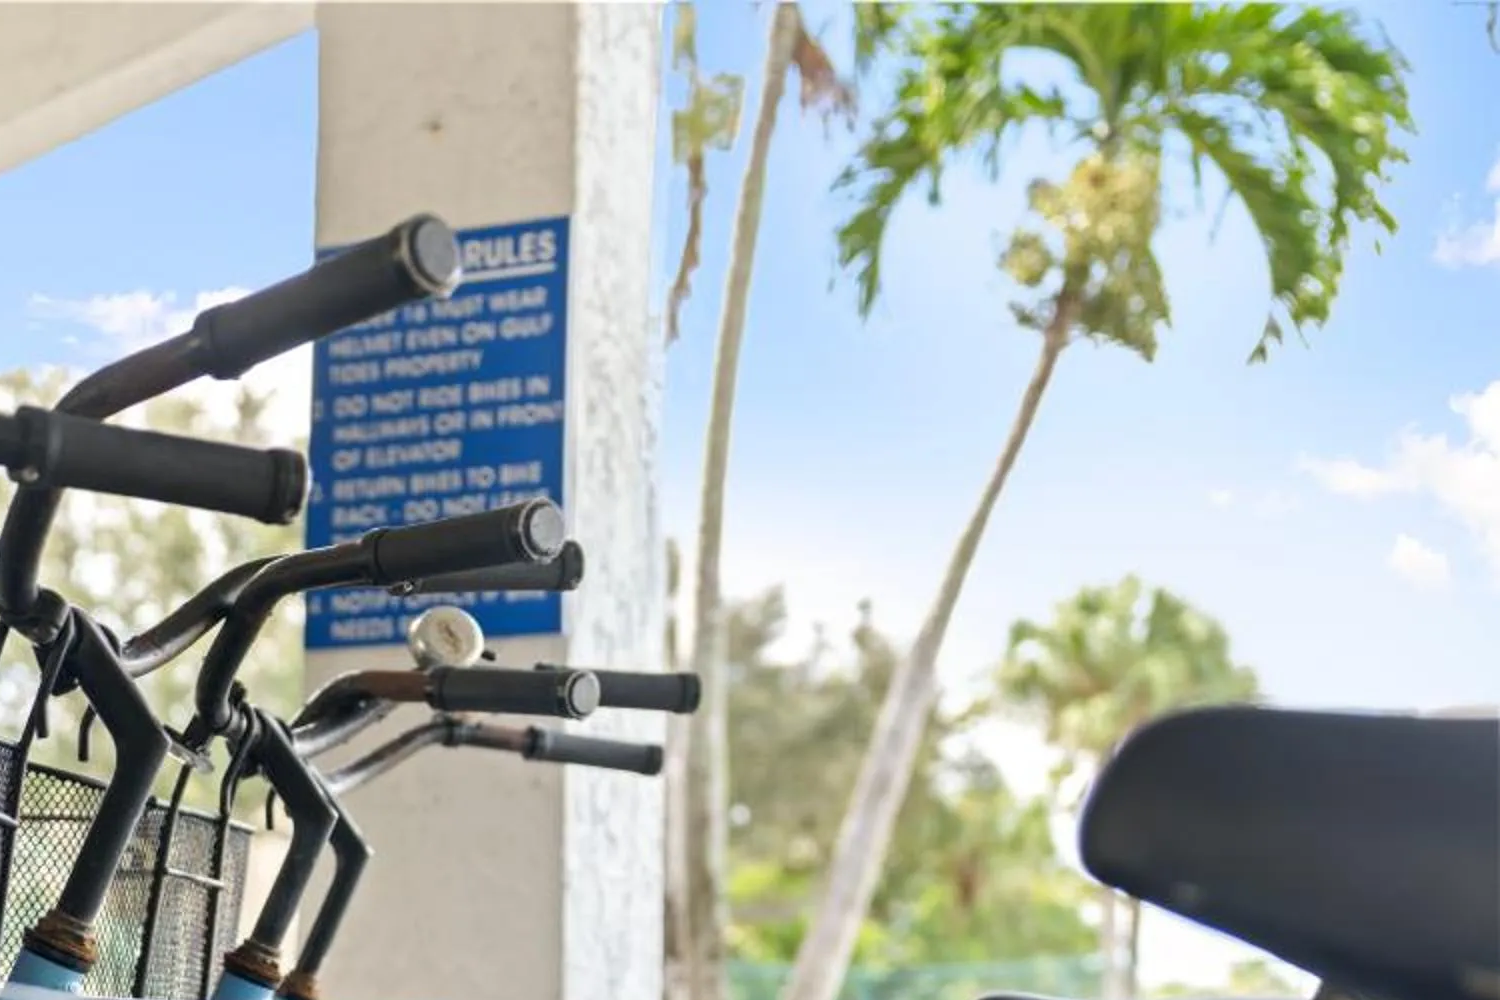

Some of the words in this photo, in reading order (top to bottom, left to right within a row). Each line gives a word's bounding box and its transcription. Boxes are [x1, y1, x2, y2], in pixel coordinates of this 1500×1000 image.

[463, 231, 557, 268] RULES
[489, 286, 548, 311] WEAR
[328, 331, 401, 359] HELMET
[406, 325, 457, 350] EVEN
[461, 321, 496, 344] ON
[500, 313, 553, 340] GULF
[384, 350, 484, 378] PROPERTY
[333, 395, 368, 418] DO
[372, 390, 414, 414] NOT
[418, 384, 463, 408] RIDE
[467, 378, 522, 403] BIKES
[526, 376, 550, 396] IN
[333, 415, 430, 443] HALLWAYS
[434, 410, 466, 435] OR
[470, 409, 494, 429] IN
[497, 400, 564, 426] FRONT
[332, 447, 361, 472] OF
[365, 439, 463, 468] ELEVATOR
[332, 475, 405, 499] RETURN
[410, 468, 462, 494] BIKES
[466, 465, 497, 489] TO
[500, 460, 542, 484] BIKE
[332, 504, 388, 528] RACK
[403, 498, 440, 522] DO
[443, 493, 486, 517] NOT
[330, 616, 396, 642] NEEDS
